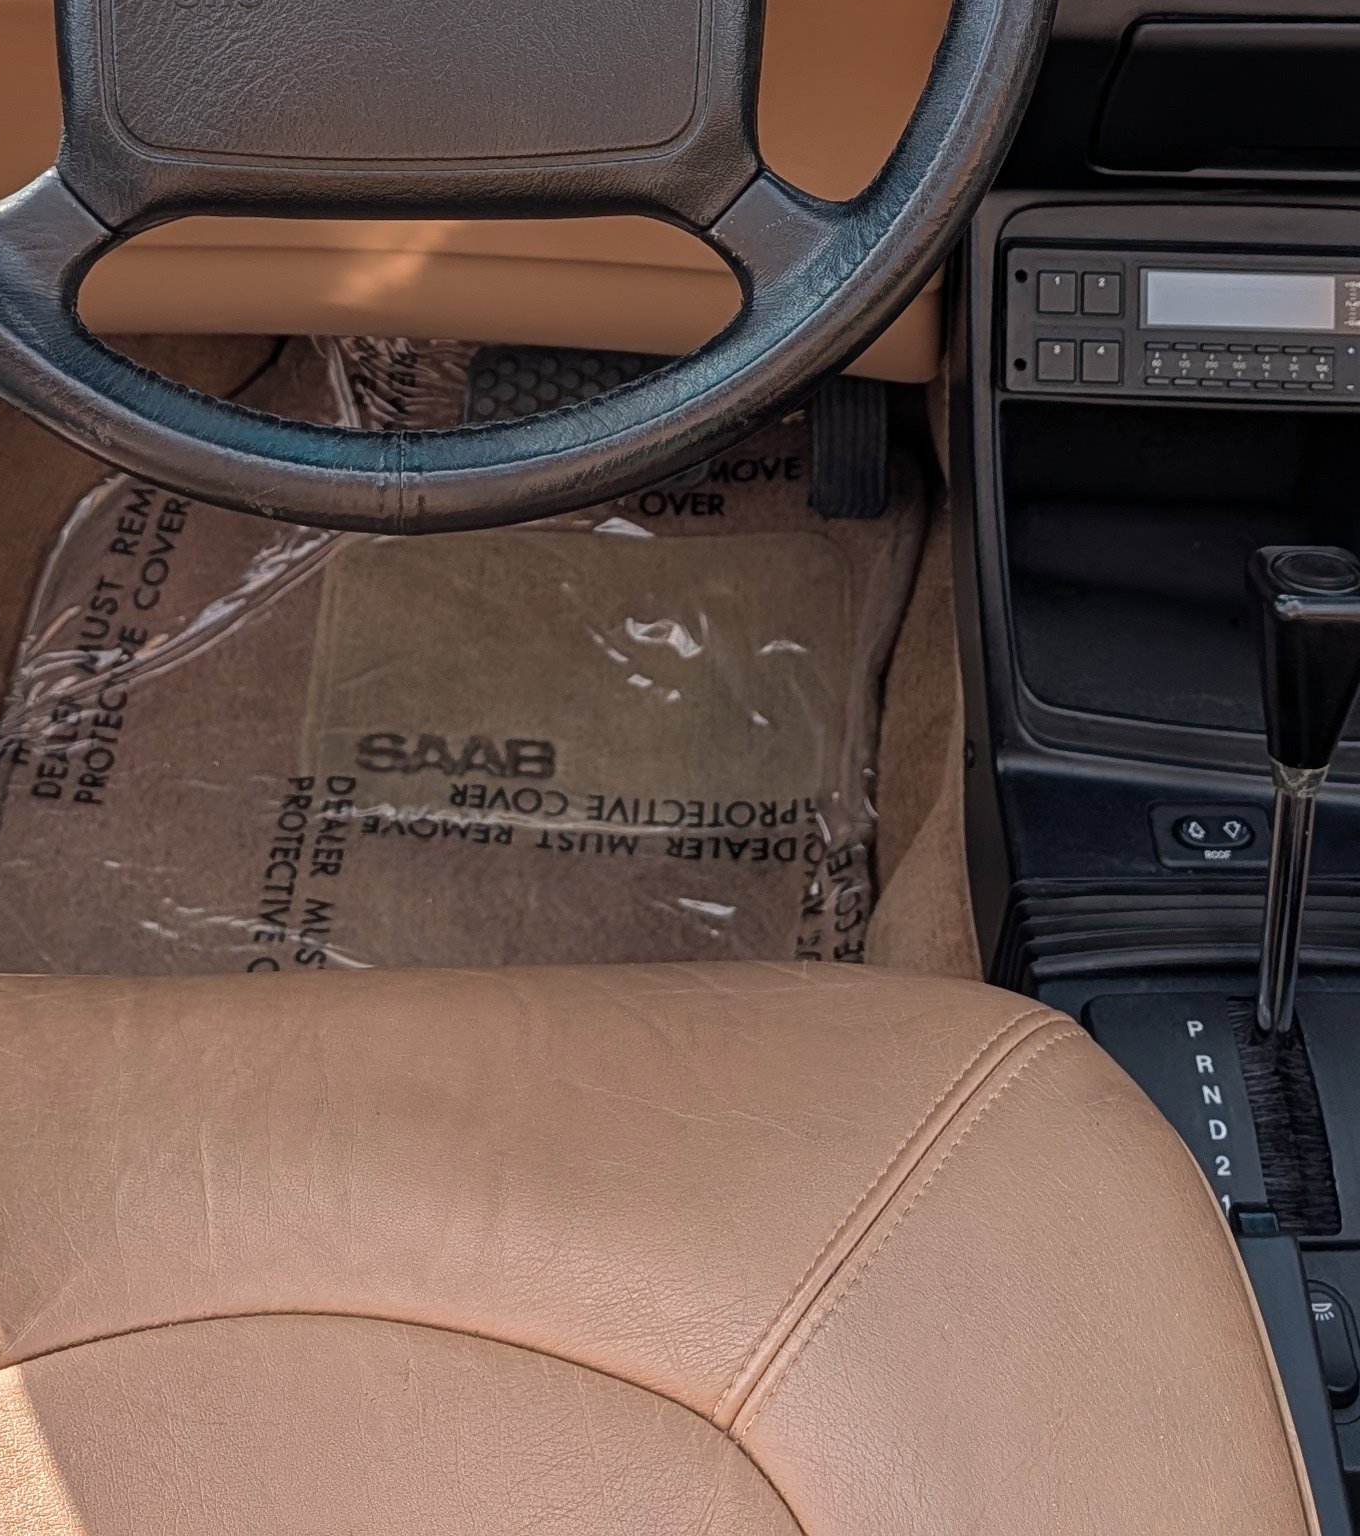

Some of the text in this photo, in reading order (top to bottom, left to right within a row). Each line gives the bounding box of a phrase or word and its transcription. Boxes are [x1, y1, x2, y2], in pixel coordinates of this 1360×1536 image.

[709, 457, 802, 483] MOVE
[638, 491, 725, 515] OVER
[110, 487, 157, 557] REM
[133, 498, 191, 612] COVER
[355, 732, 557, 780] SAAB
[448, 783, 798, 828] PROTECTIVE COVER
[361, 814, 797, 863] DEALER MUST REMOVE
[253, 776, 316, 944] PROTECTIVE
[295, 775, 357, 970] DEALER MUS
[1187, 1020, 1204, 1037] P
[1195, 1055, 1215, 1074] R
[1202, 1085, 1223, 1104] N
[1208, 1119, 1228, 1140] D
[1215, 1155, 1232, 1176] 2
